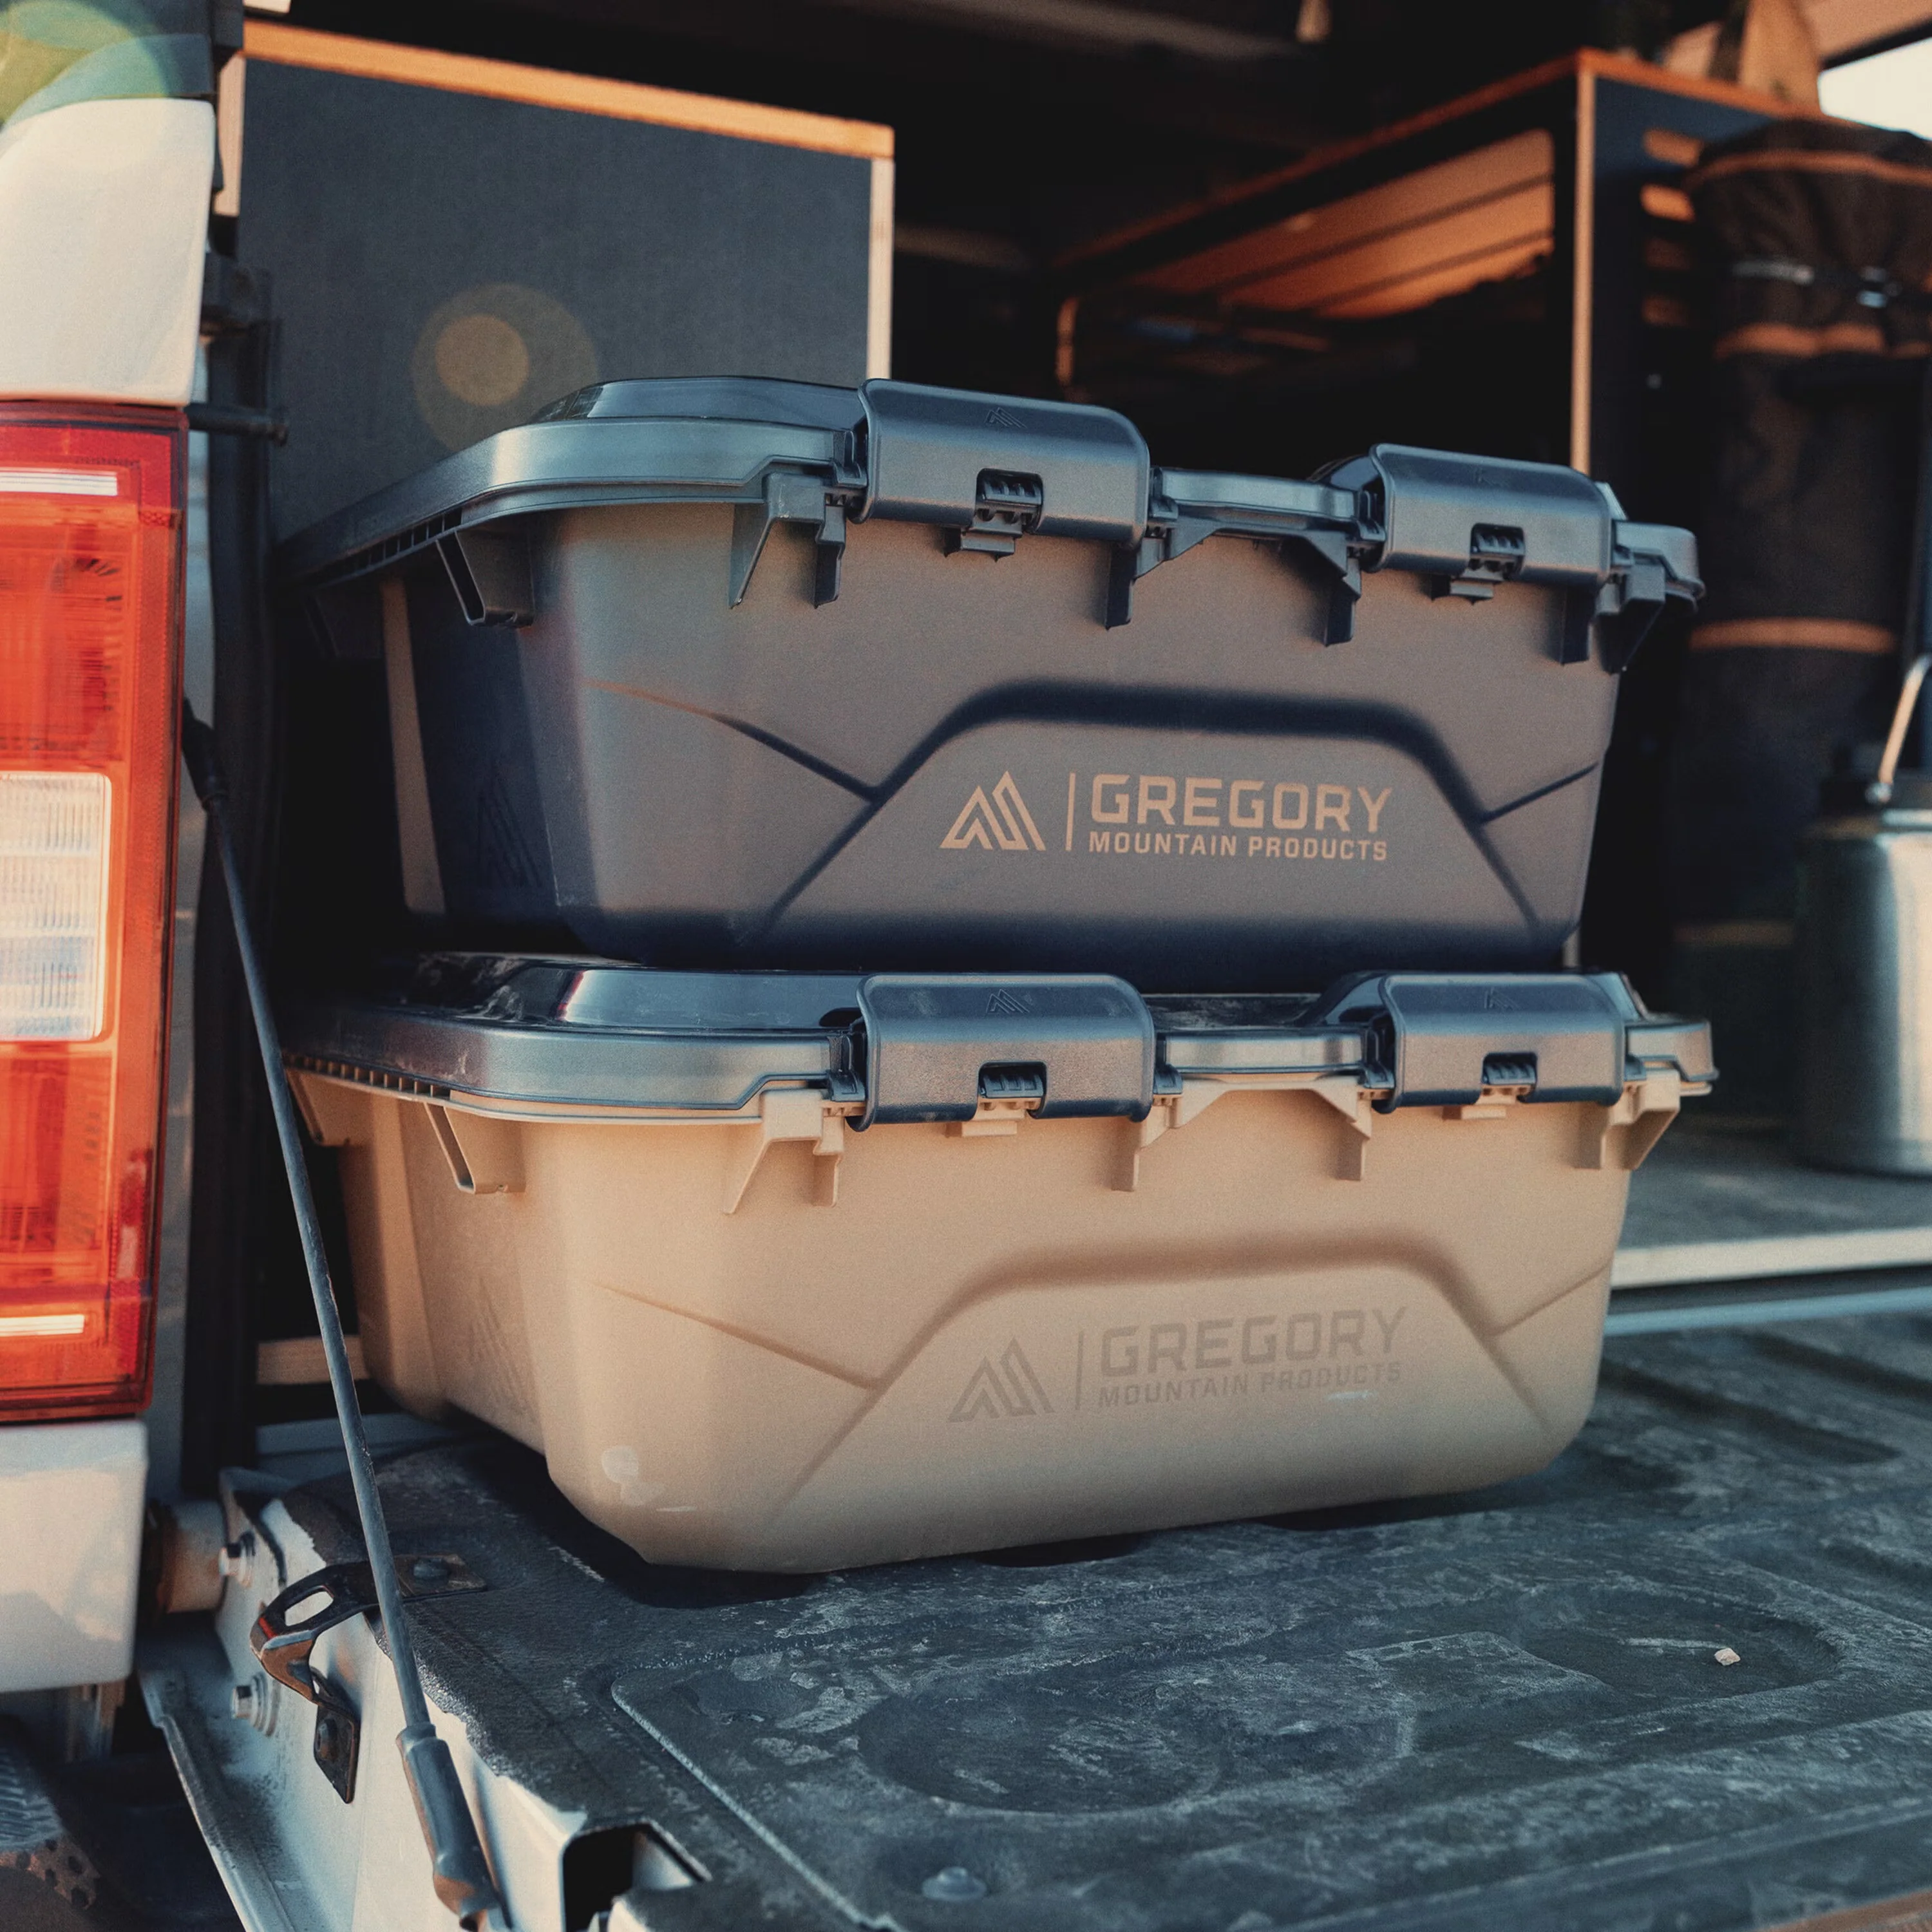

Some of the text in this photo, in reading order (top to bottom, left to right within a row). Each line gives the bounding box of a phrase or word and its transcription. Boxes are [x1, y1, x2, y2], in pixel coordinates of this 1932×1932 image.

[1091, 774, 1392, 833] GREGORY
[1088, 832, 1388, 860] MOUNTAIN PRODUCTS
[1101, 1306, 1407, 1377] GREGORY
[1098, 1361, 1402, 1407] MOUNTAIN PRODUCTS
